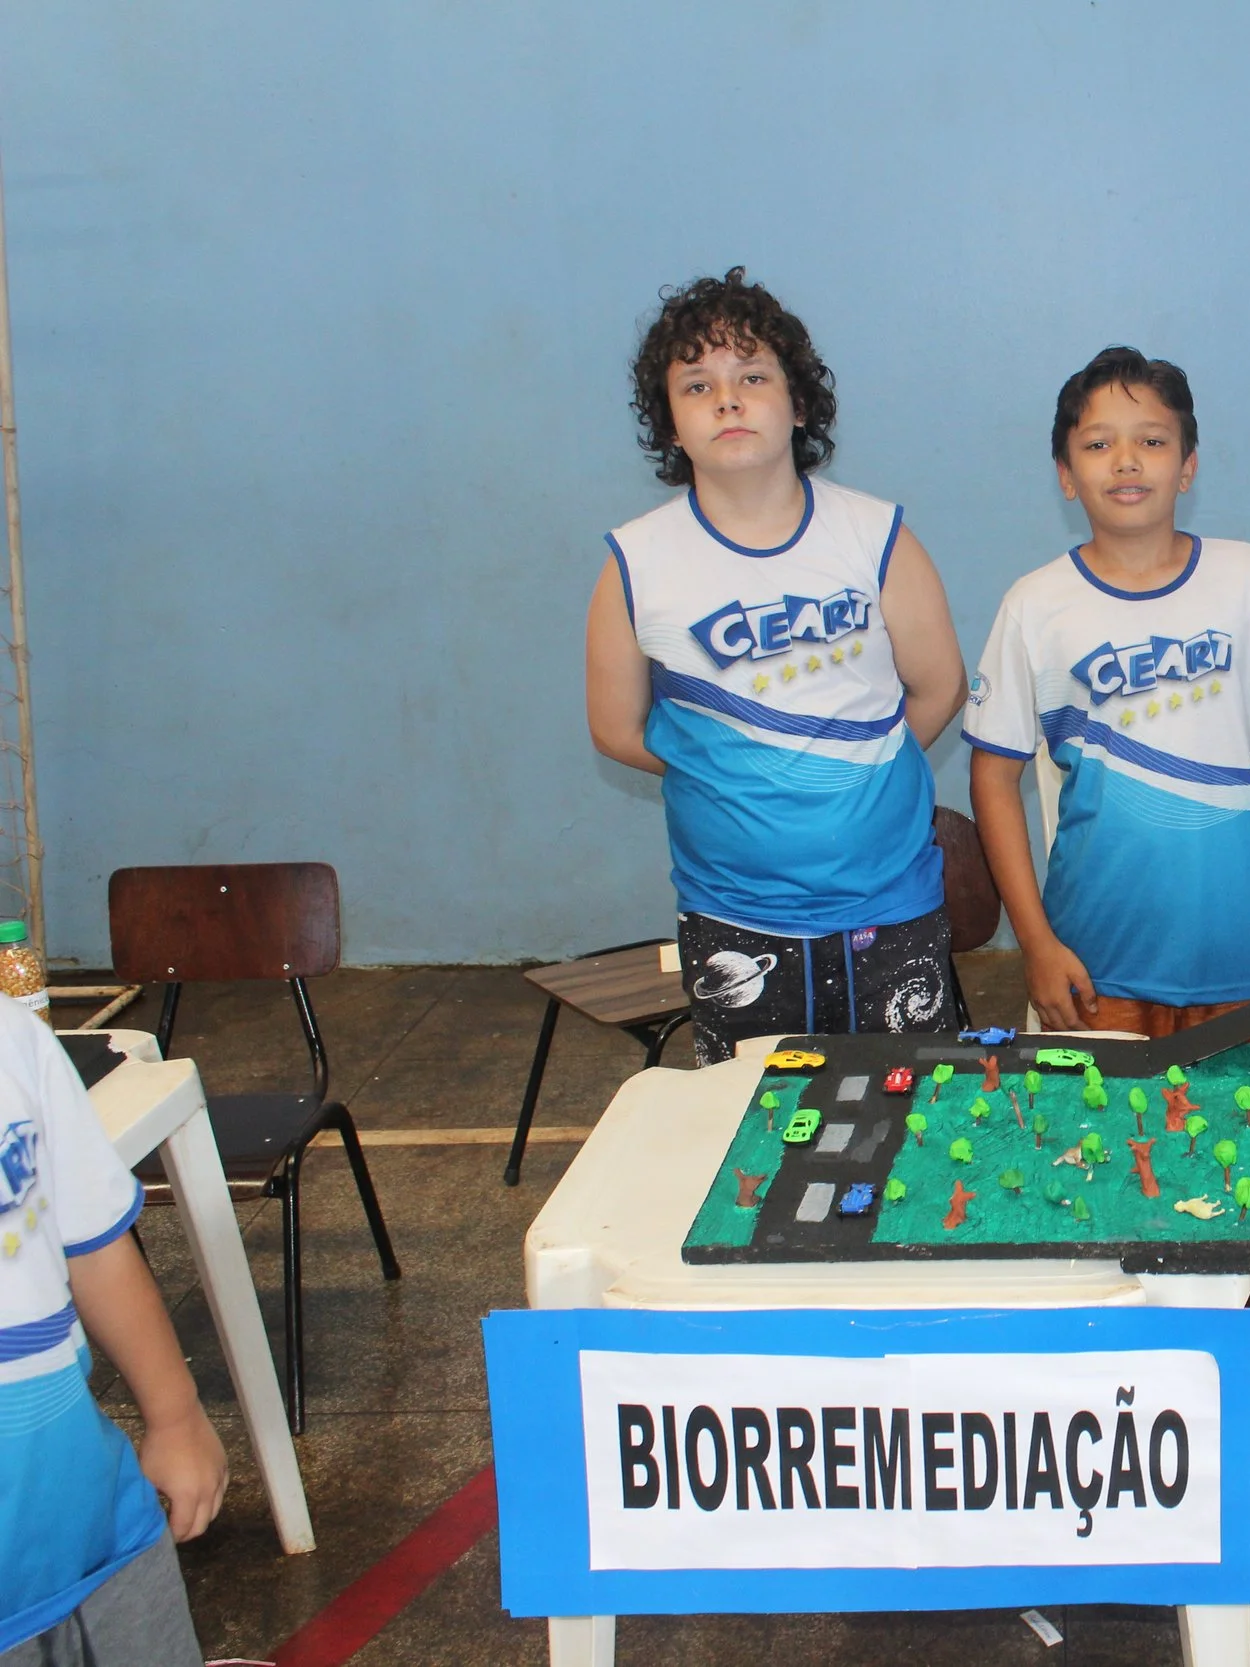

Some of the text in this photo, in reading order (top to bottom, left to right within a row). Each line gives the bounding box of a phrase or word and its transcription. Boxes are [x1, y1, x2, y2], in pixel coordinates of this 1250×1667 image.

[708, 592, 872, 657] CEART
[1086, 633, 1232, 694] CEART
[618, 1386, 1189, 1537] BIORREMEDIAÇÃO
